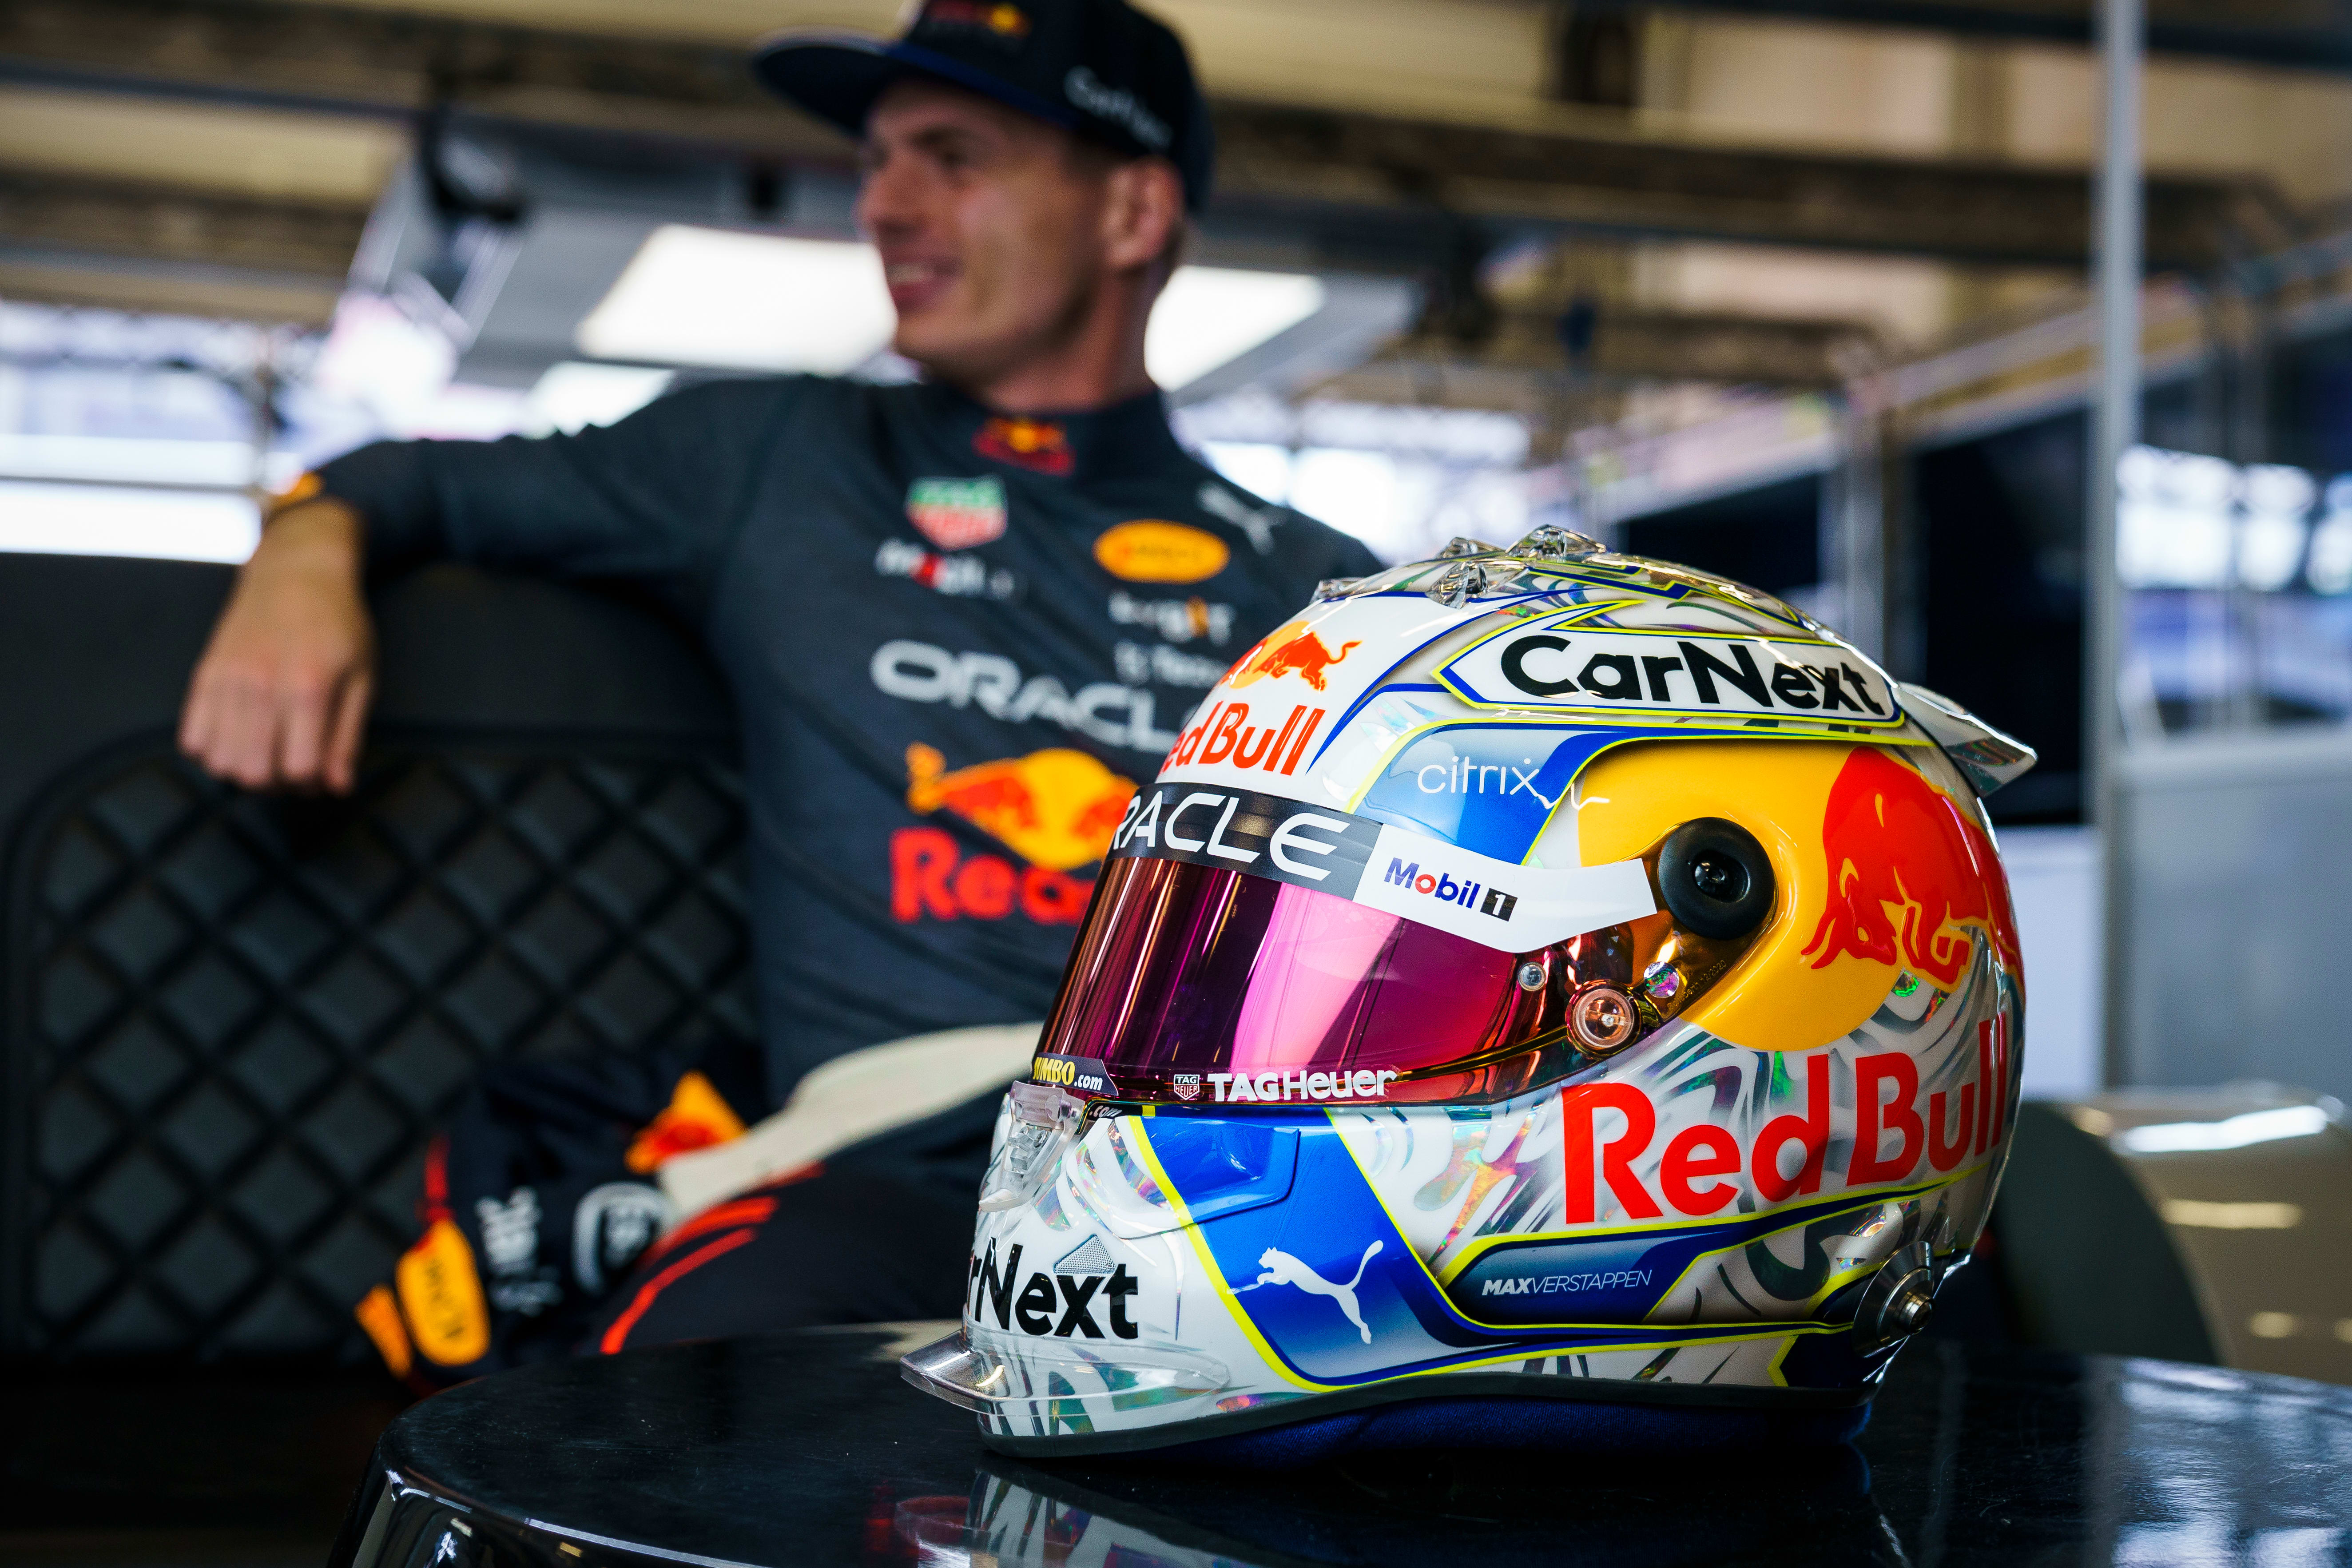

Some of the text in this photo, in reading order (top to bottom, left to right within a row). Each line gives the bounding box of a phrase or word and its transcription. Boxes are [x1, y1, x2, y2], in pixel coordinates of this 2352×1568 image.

[871, 639, 1198, 754] ORACL
[1501, 635, 1880, 715] CarNext
[1199, 703, 1326, 776] Bull
[1418, 756, 1540, 796] citrix
[1113, 790, 1350, 881] RACLE
[1384, 857, 1481, 909] Mobil
[1175, 1085, 1198, 1097] HEUER
[1176, 1076, 1197, 1084] TAG
[1562, 1011, 2006, 1224] Red Bull
